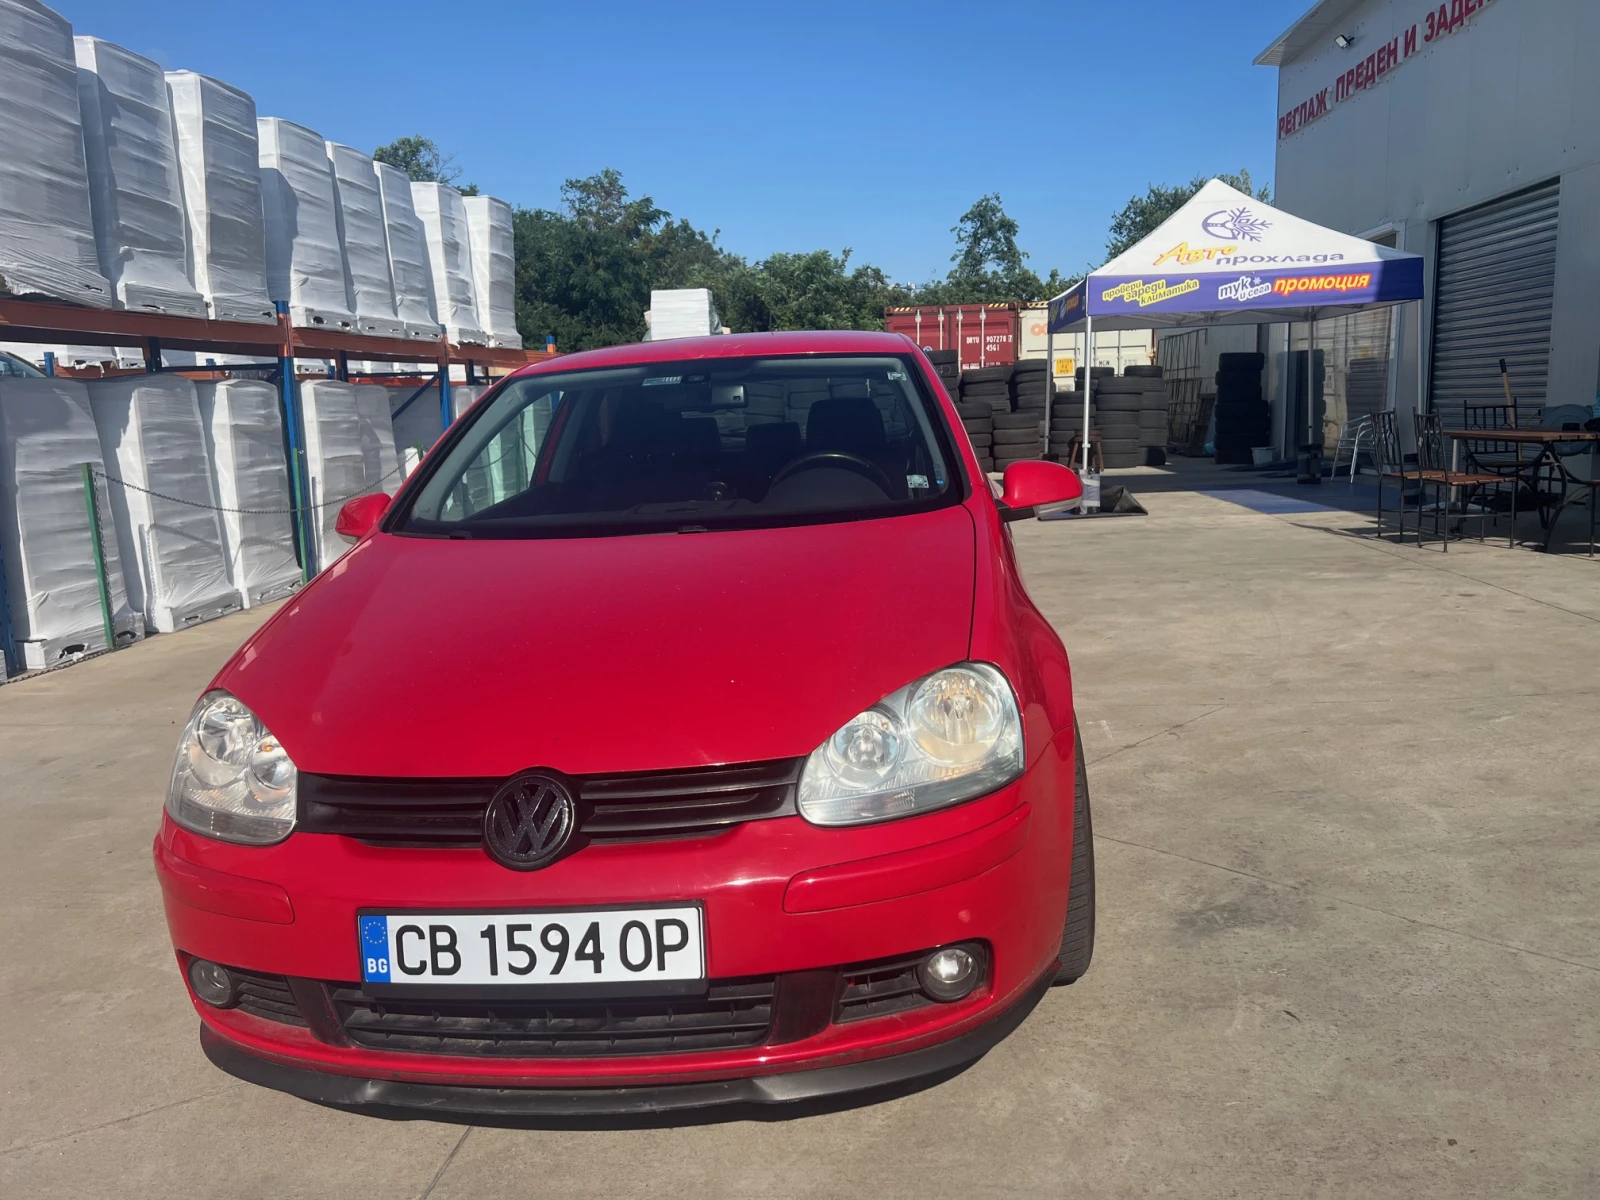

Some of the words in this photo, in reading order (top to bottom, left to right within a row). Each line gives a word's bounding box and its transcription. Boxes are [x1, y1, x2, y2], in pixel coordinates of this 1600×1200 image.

[1278, 87, 1328, 140] РЕГЛАЖ
[1335, 36, 1398, 103] ПРЕДЕН
[1404, 23, 1417, 58] И
[1216, 253, 1344, 266] прохлада
[1103, 280, 1142, 299] провери
[1125, 280, 1165, 300] зареди
[1140, 280, 1199, 305] климатика
[1220, 276, 1251, 298] тук
[1248, 285, 1270, 298] сега
[1274, 275, 1370, 294] промоция
[395, 924, 462, 976] CB
[480, 921, 605, 976] 1594
[619, 918, 690, 973] OP
[367, 957, 388, 974] BG
